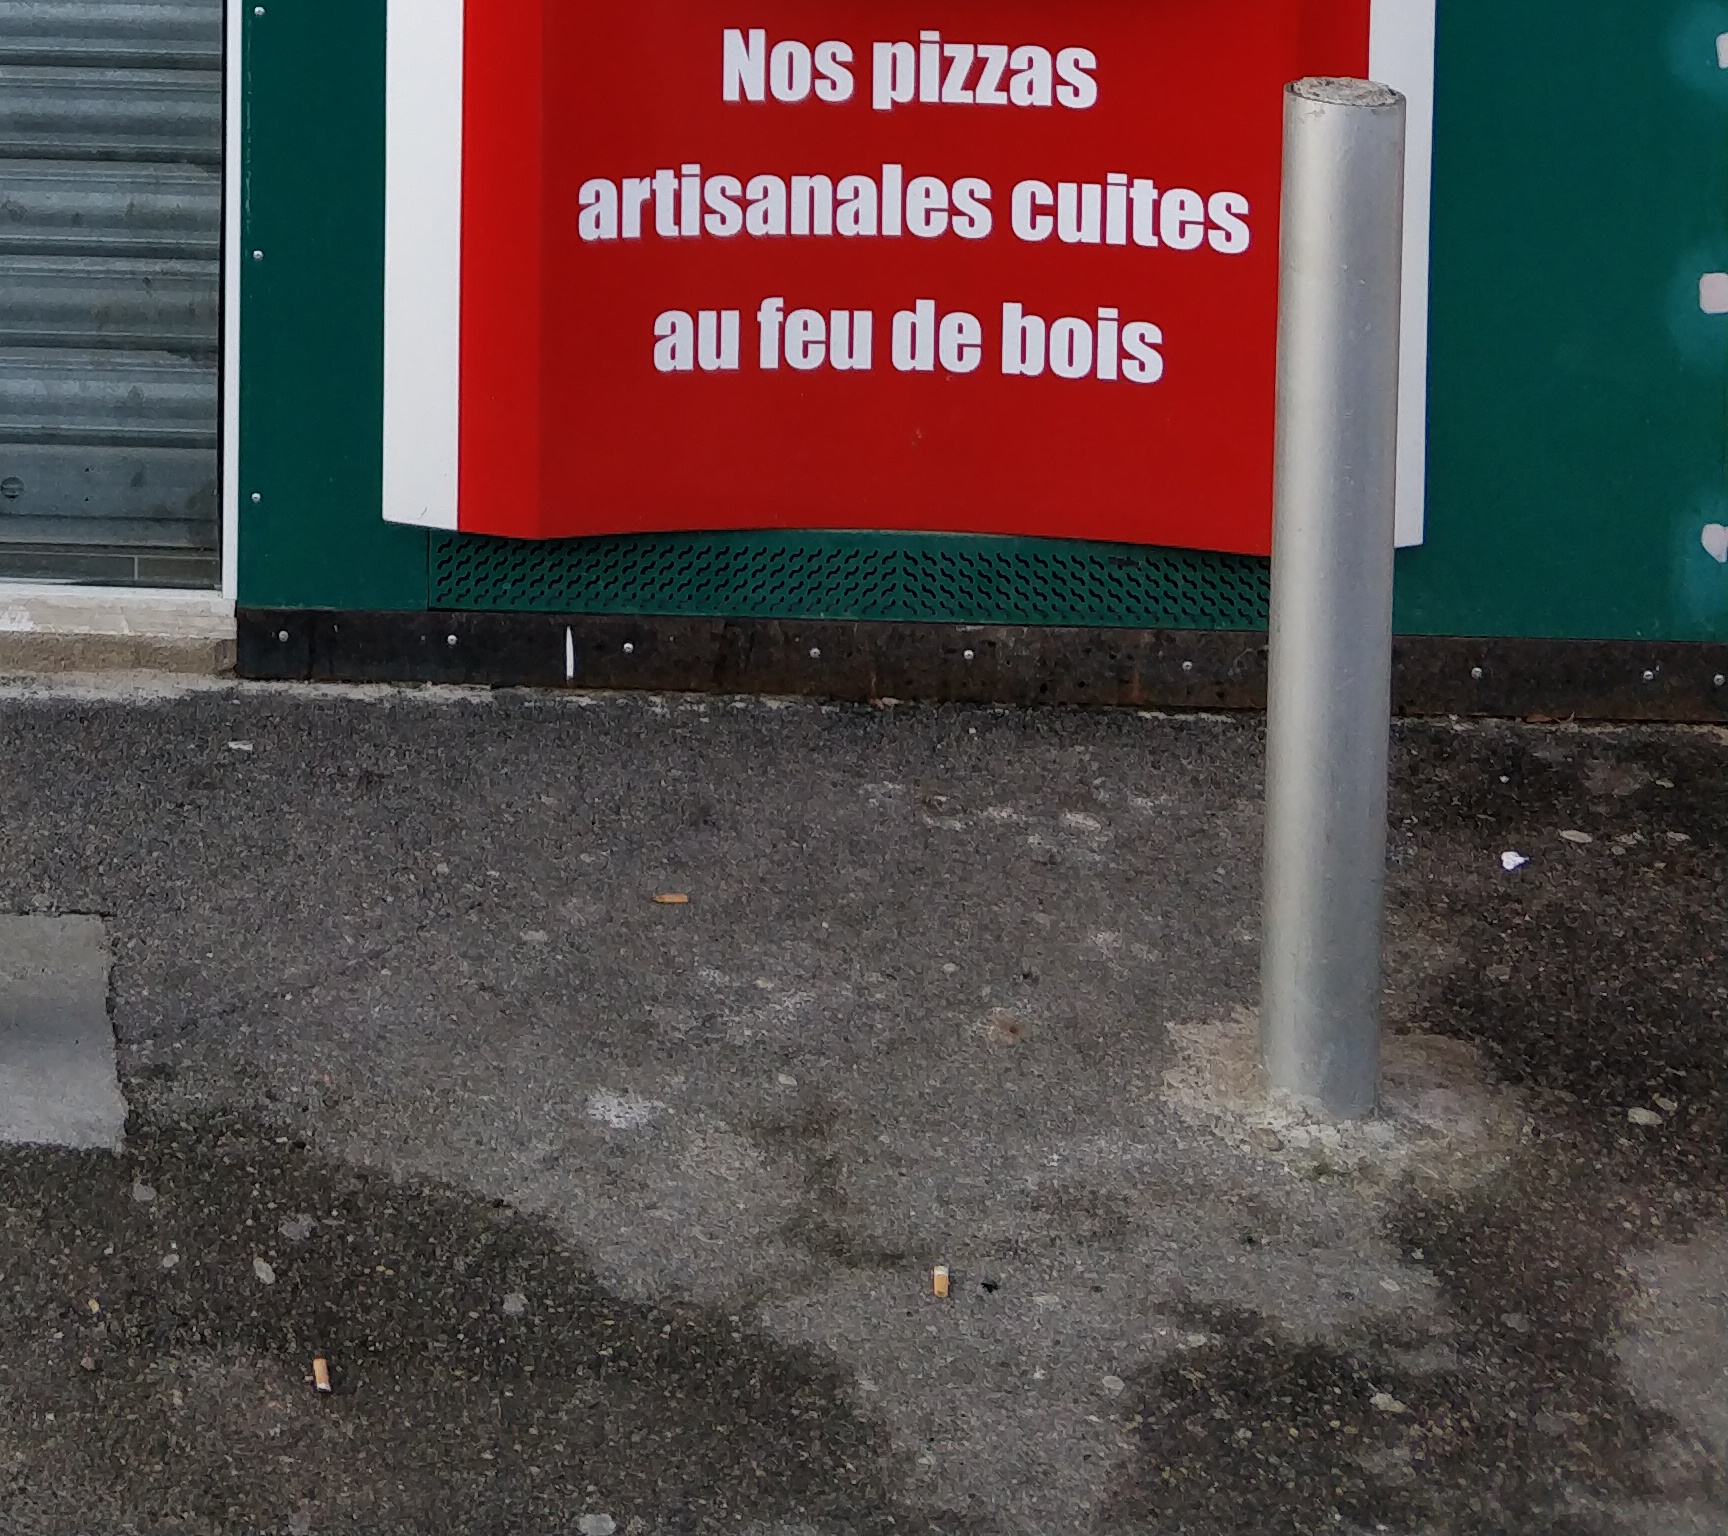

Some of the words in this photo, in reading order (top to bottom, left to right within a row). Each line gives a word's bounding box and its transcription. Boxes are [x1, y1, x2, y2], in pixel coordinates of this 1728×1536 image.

[722, 28, 854, 103] Nos
[872, 30, 1098, 110] pizzas
[578, 164, 992, 240] artisanales
[1011, 173, 1250, 254] cuites
[653, 307, 740, 372] au
[757, 298, 872, 370] feu
[891, 299, 983, 374] de
[1001, 302, 1164, 384] bois
